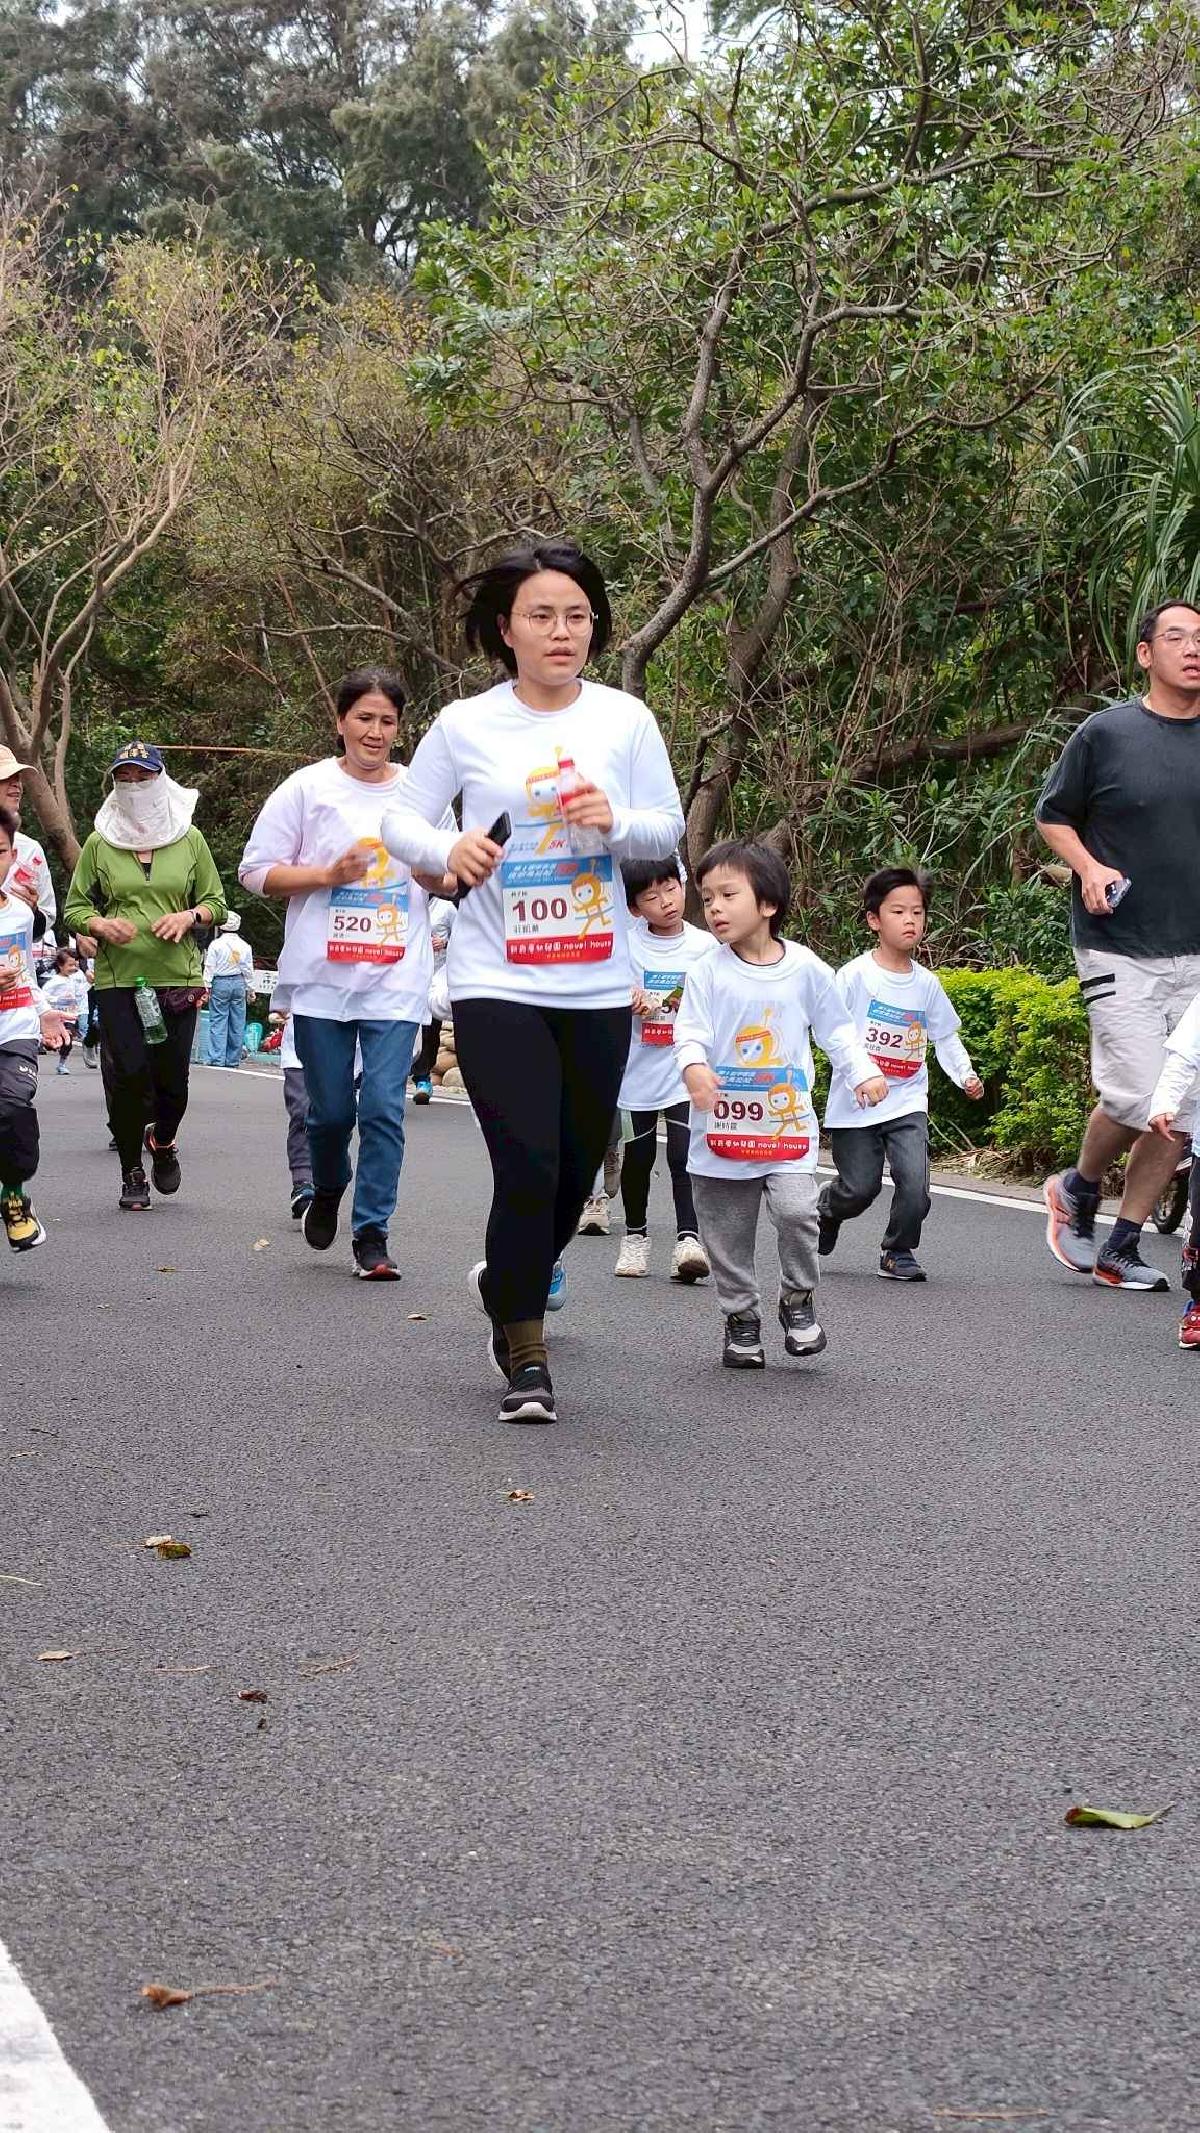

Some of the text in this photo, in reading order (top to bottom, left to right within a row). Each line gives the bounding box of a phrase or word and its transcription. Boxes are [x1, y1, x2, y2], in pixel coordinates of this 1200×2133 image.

[512, 898, 568, 921] 100
[334, 915, 372, 933] 520
[865, 1028, 903, 1048] 392
[713, 1100, 764, 1121] 099
